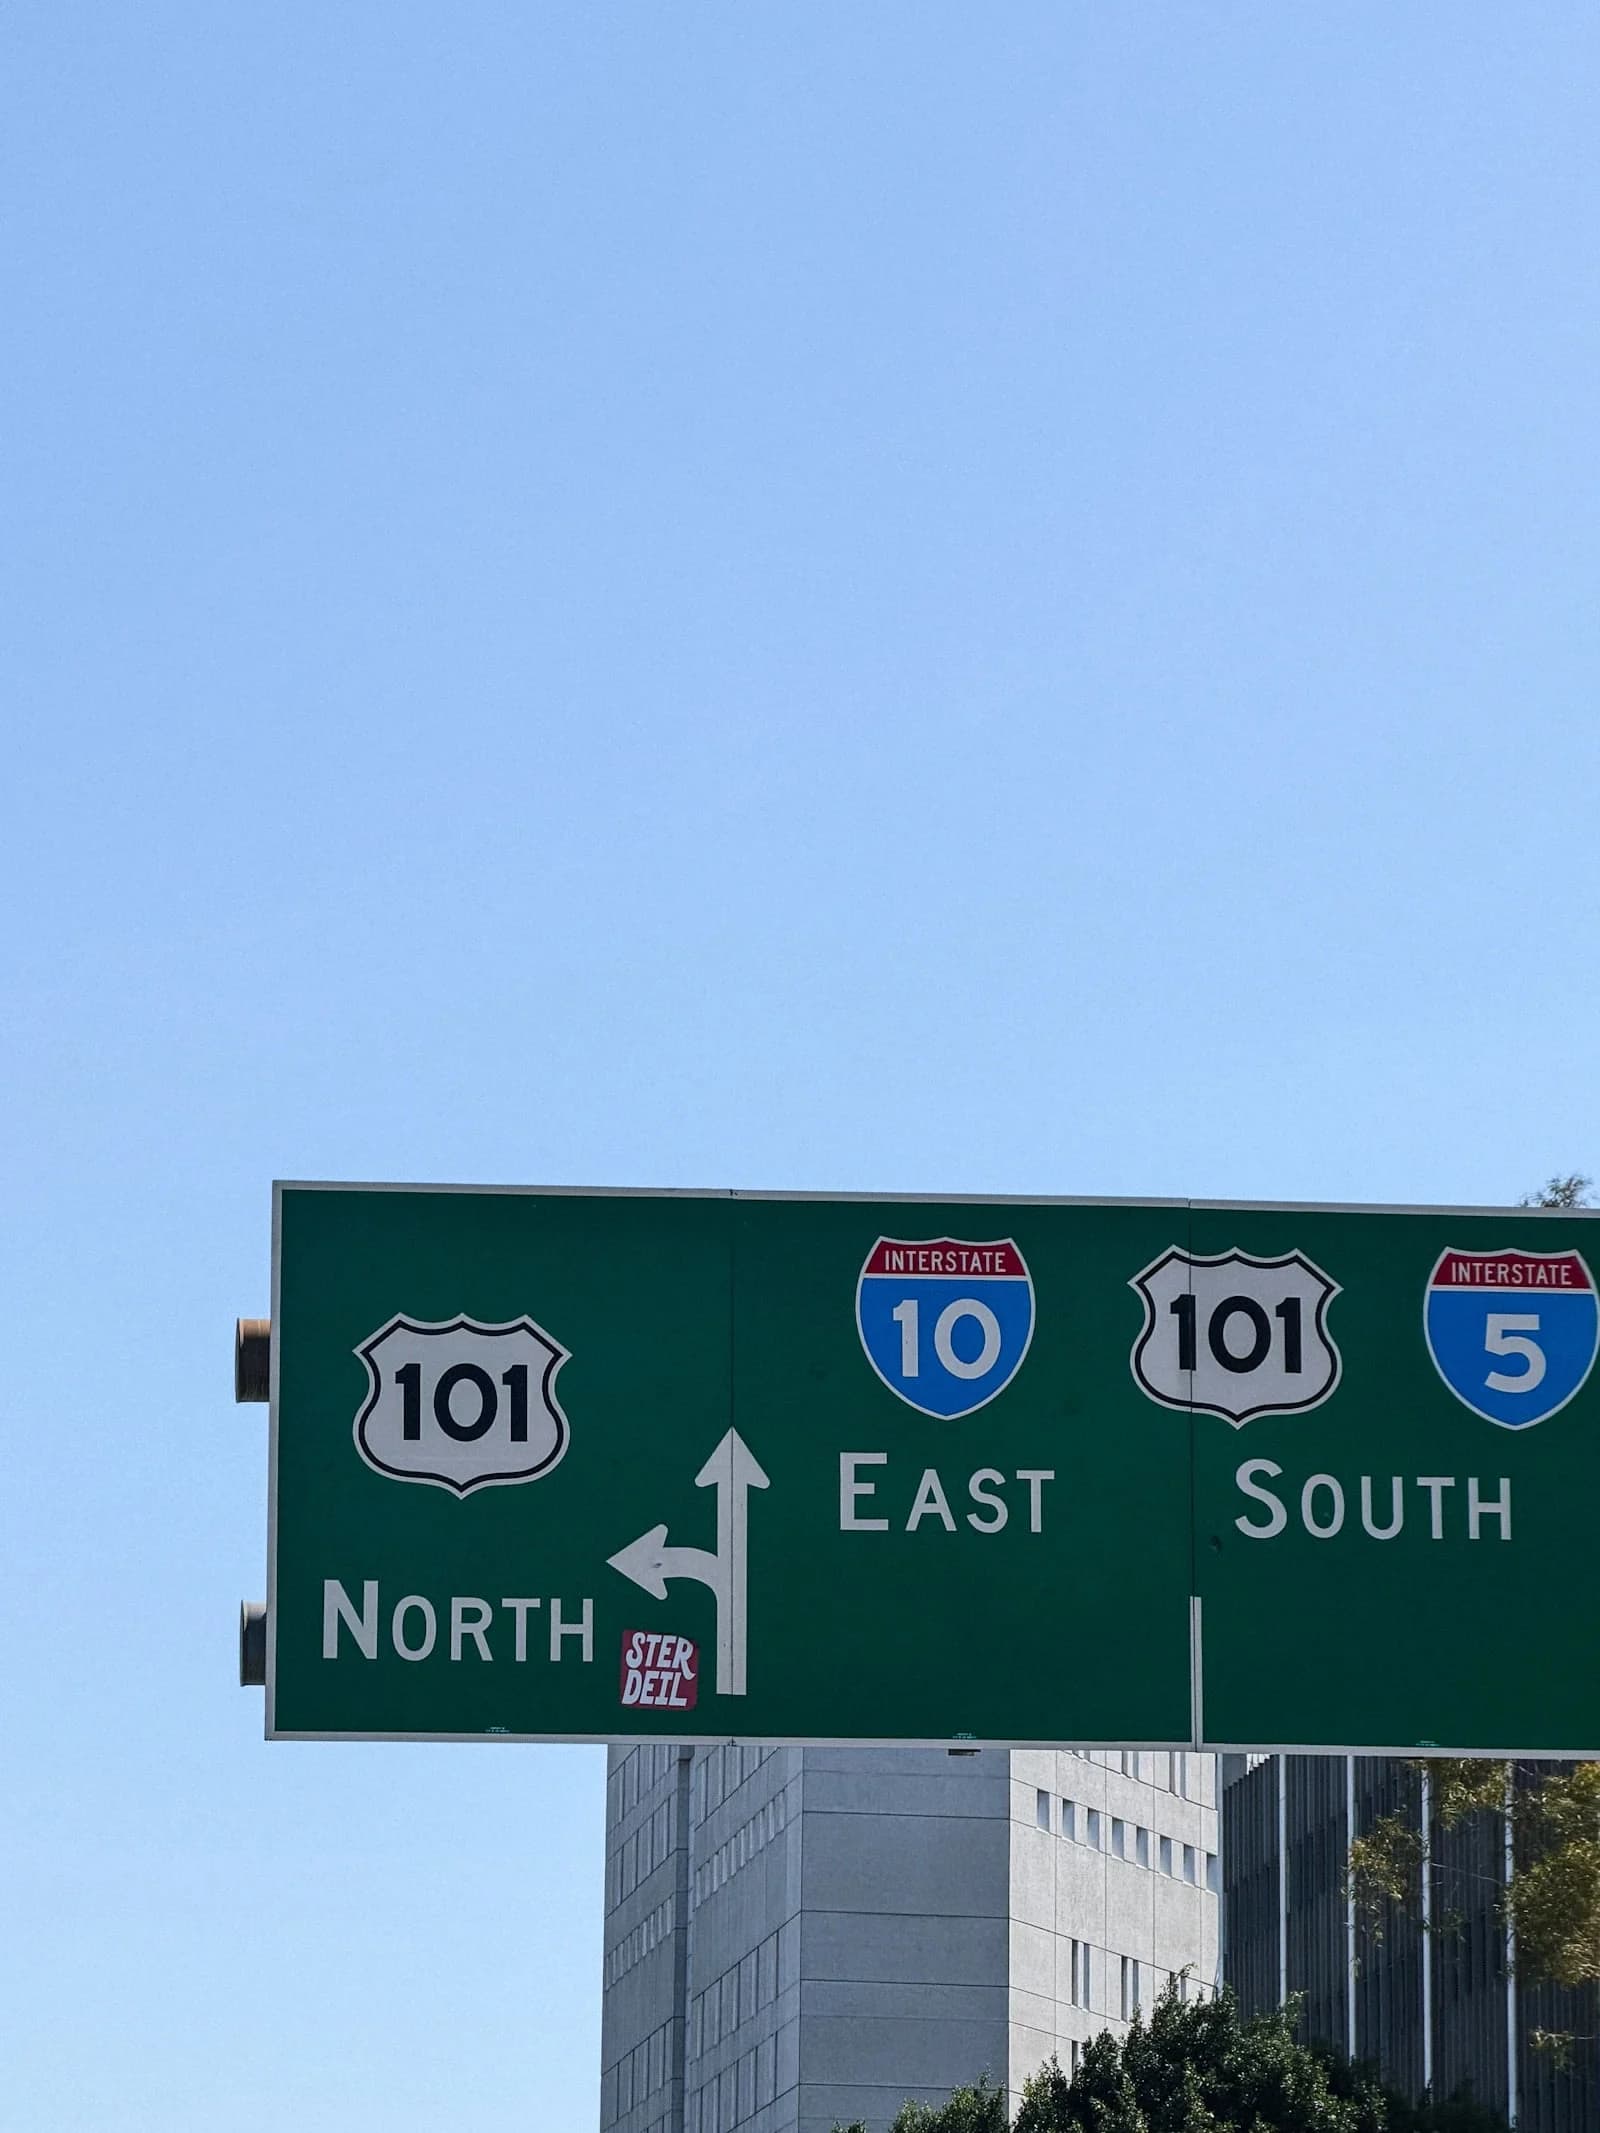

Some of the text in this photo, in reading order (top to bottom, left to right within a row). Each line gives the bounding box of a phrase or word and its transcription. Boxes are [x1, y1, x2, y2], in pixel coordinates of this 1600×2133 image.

[883, 1250, 1007, 1274] INTERSTATE
[1450, 1261, 1573, 1286] INTERSTATE
[892, 1298, 1002, 1379] 10
[1170, 1294, 1302, 1374] 101
[1483, 1313, 1547, 1393] 5
[395, 1363, 528, 1442] 101
[839, 1452, 1055, 1533] EAST
[1235, 1459, 1513, 1541] SOUTH
[322, 1579, 594, 1662] NORTH
[625, 1631, 696, 1681] STER
[621, 1669, 688, 1707] DEIL
